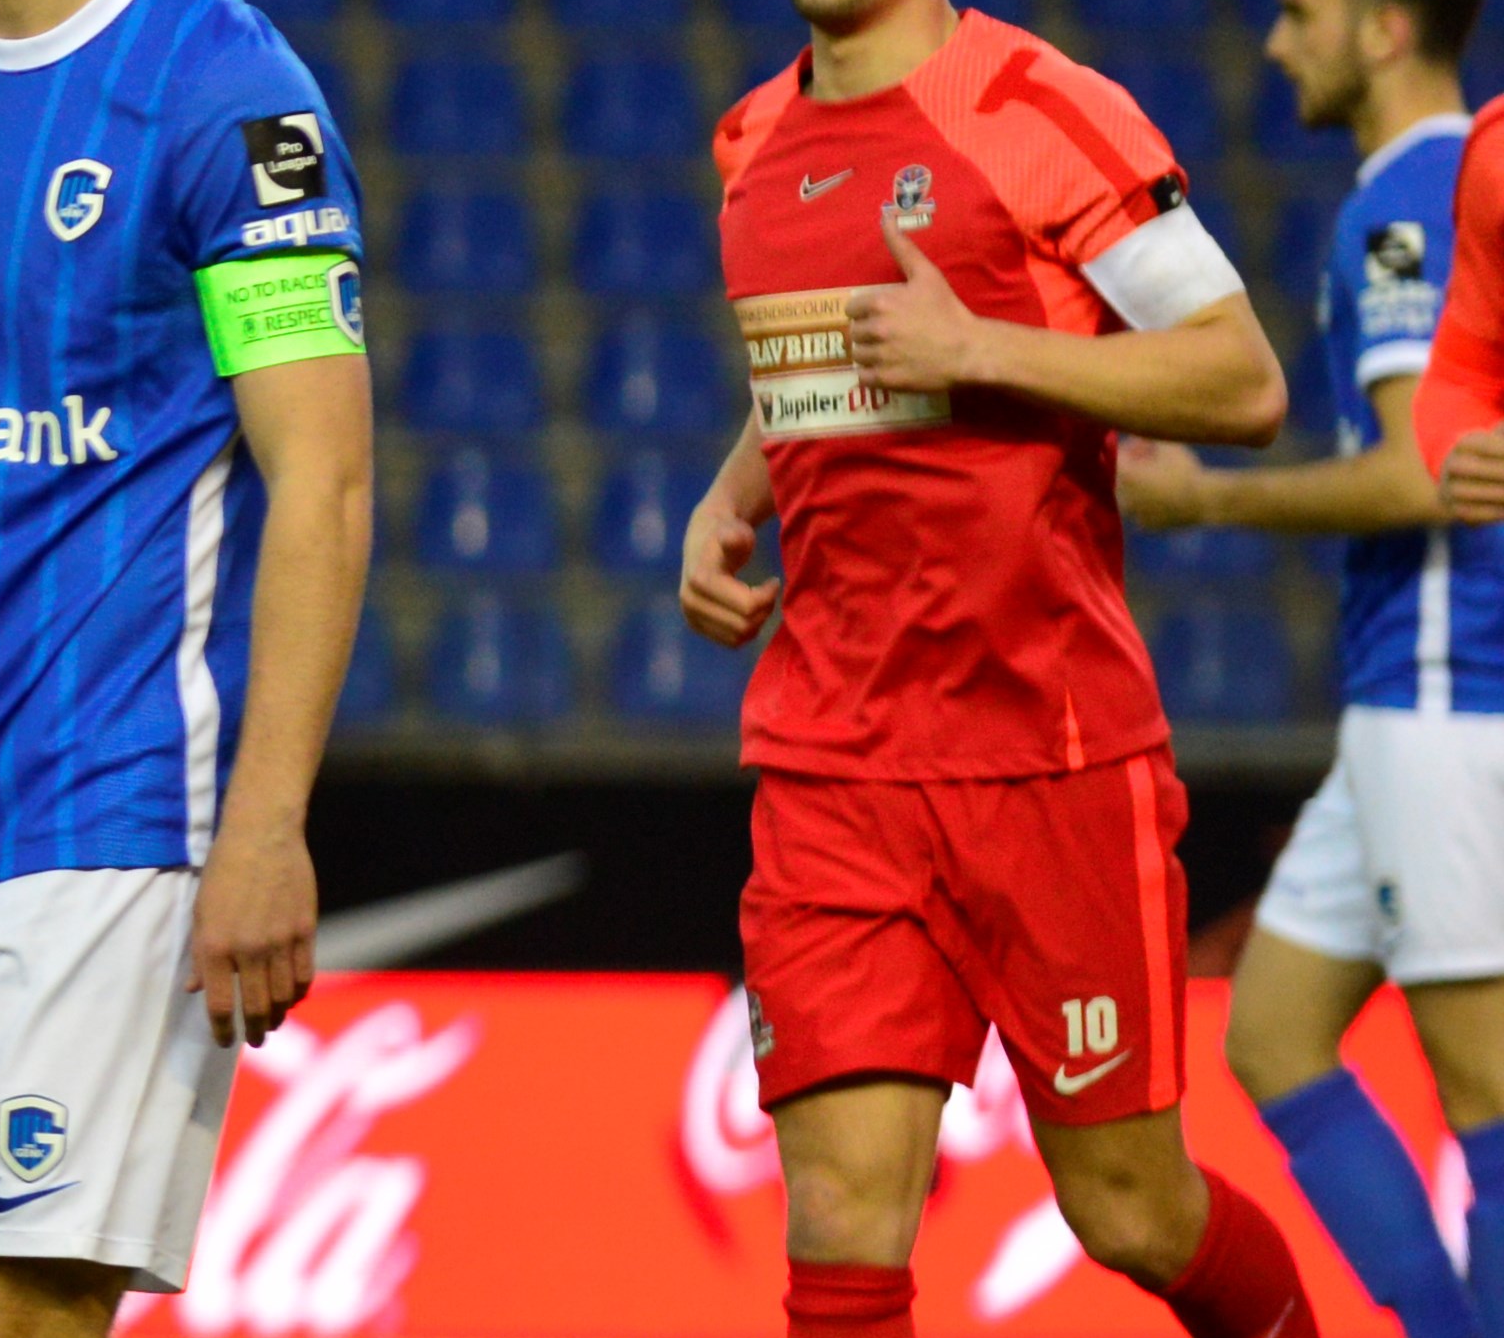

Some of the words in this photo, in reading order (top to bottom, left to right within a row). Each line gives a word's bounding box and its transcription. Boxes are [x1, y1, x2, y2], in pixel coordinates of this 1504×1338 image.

[241, 206, 349, 247] aqua
[252, 281, 276, 297] TO
[279, 273, 328, 294] RACIS
[265, 307, 331, 332] RESPEC
[748, 330, 847, 367] RAVBIER
[778, 390, 845, 420] Jupiler
[1061, 995, 1118, 1058] 10
